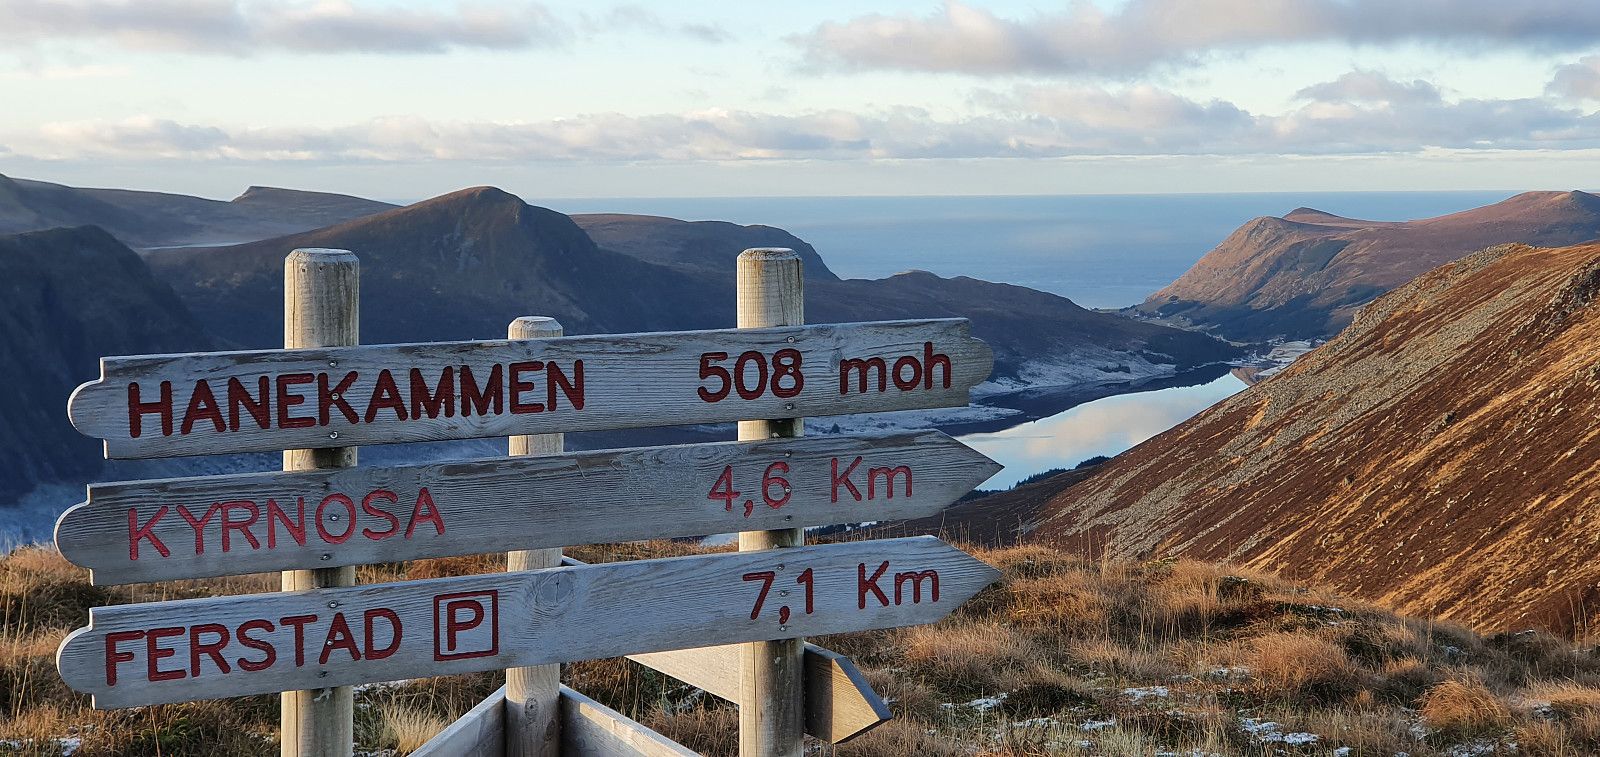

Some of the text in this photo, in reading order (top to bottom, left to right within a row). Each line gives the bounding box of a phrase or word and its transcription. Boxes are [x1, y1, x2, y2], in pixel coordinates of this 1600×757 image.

[128, 341, 952, 437] HANEKAMMEN 508 moh
[127, 456, 913, 561] KYRNOSA 4,6 Km
[105, 608, 403, 686] FERSTAD
[743, 567, 815, 625] 7,1
[857, 560, 940, 609] Km
